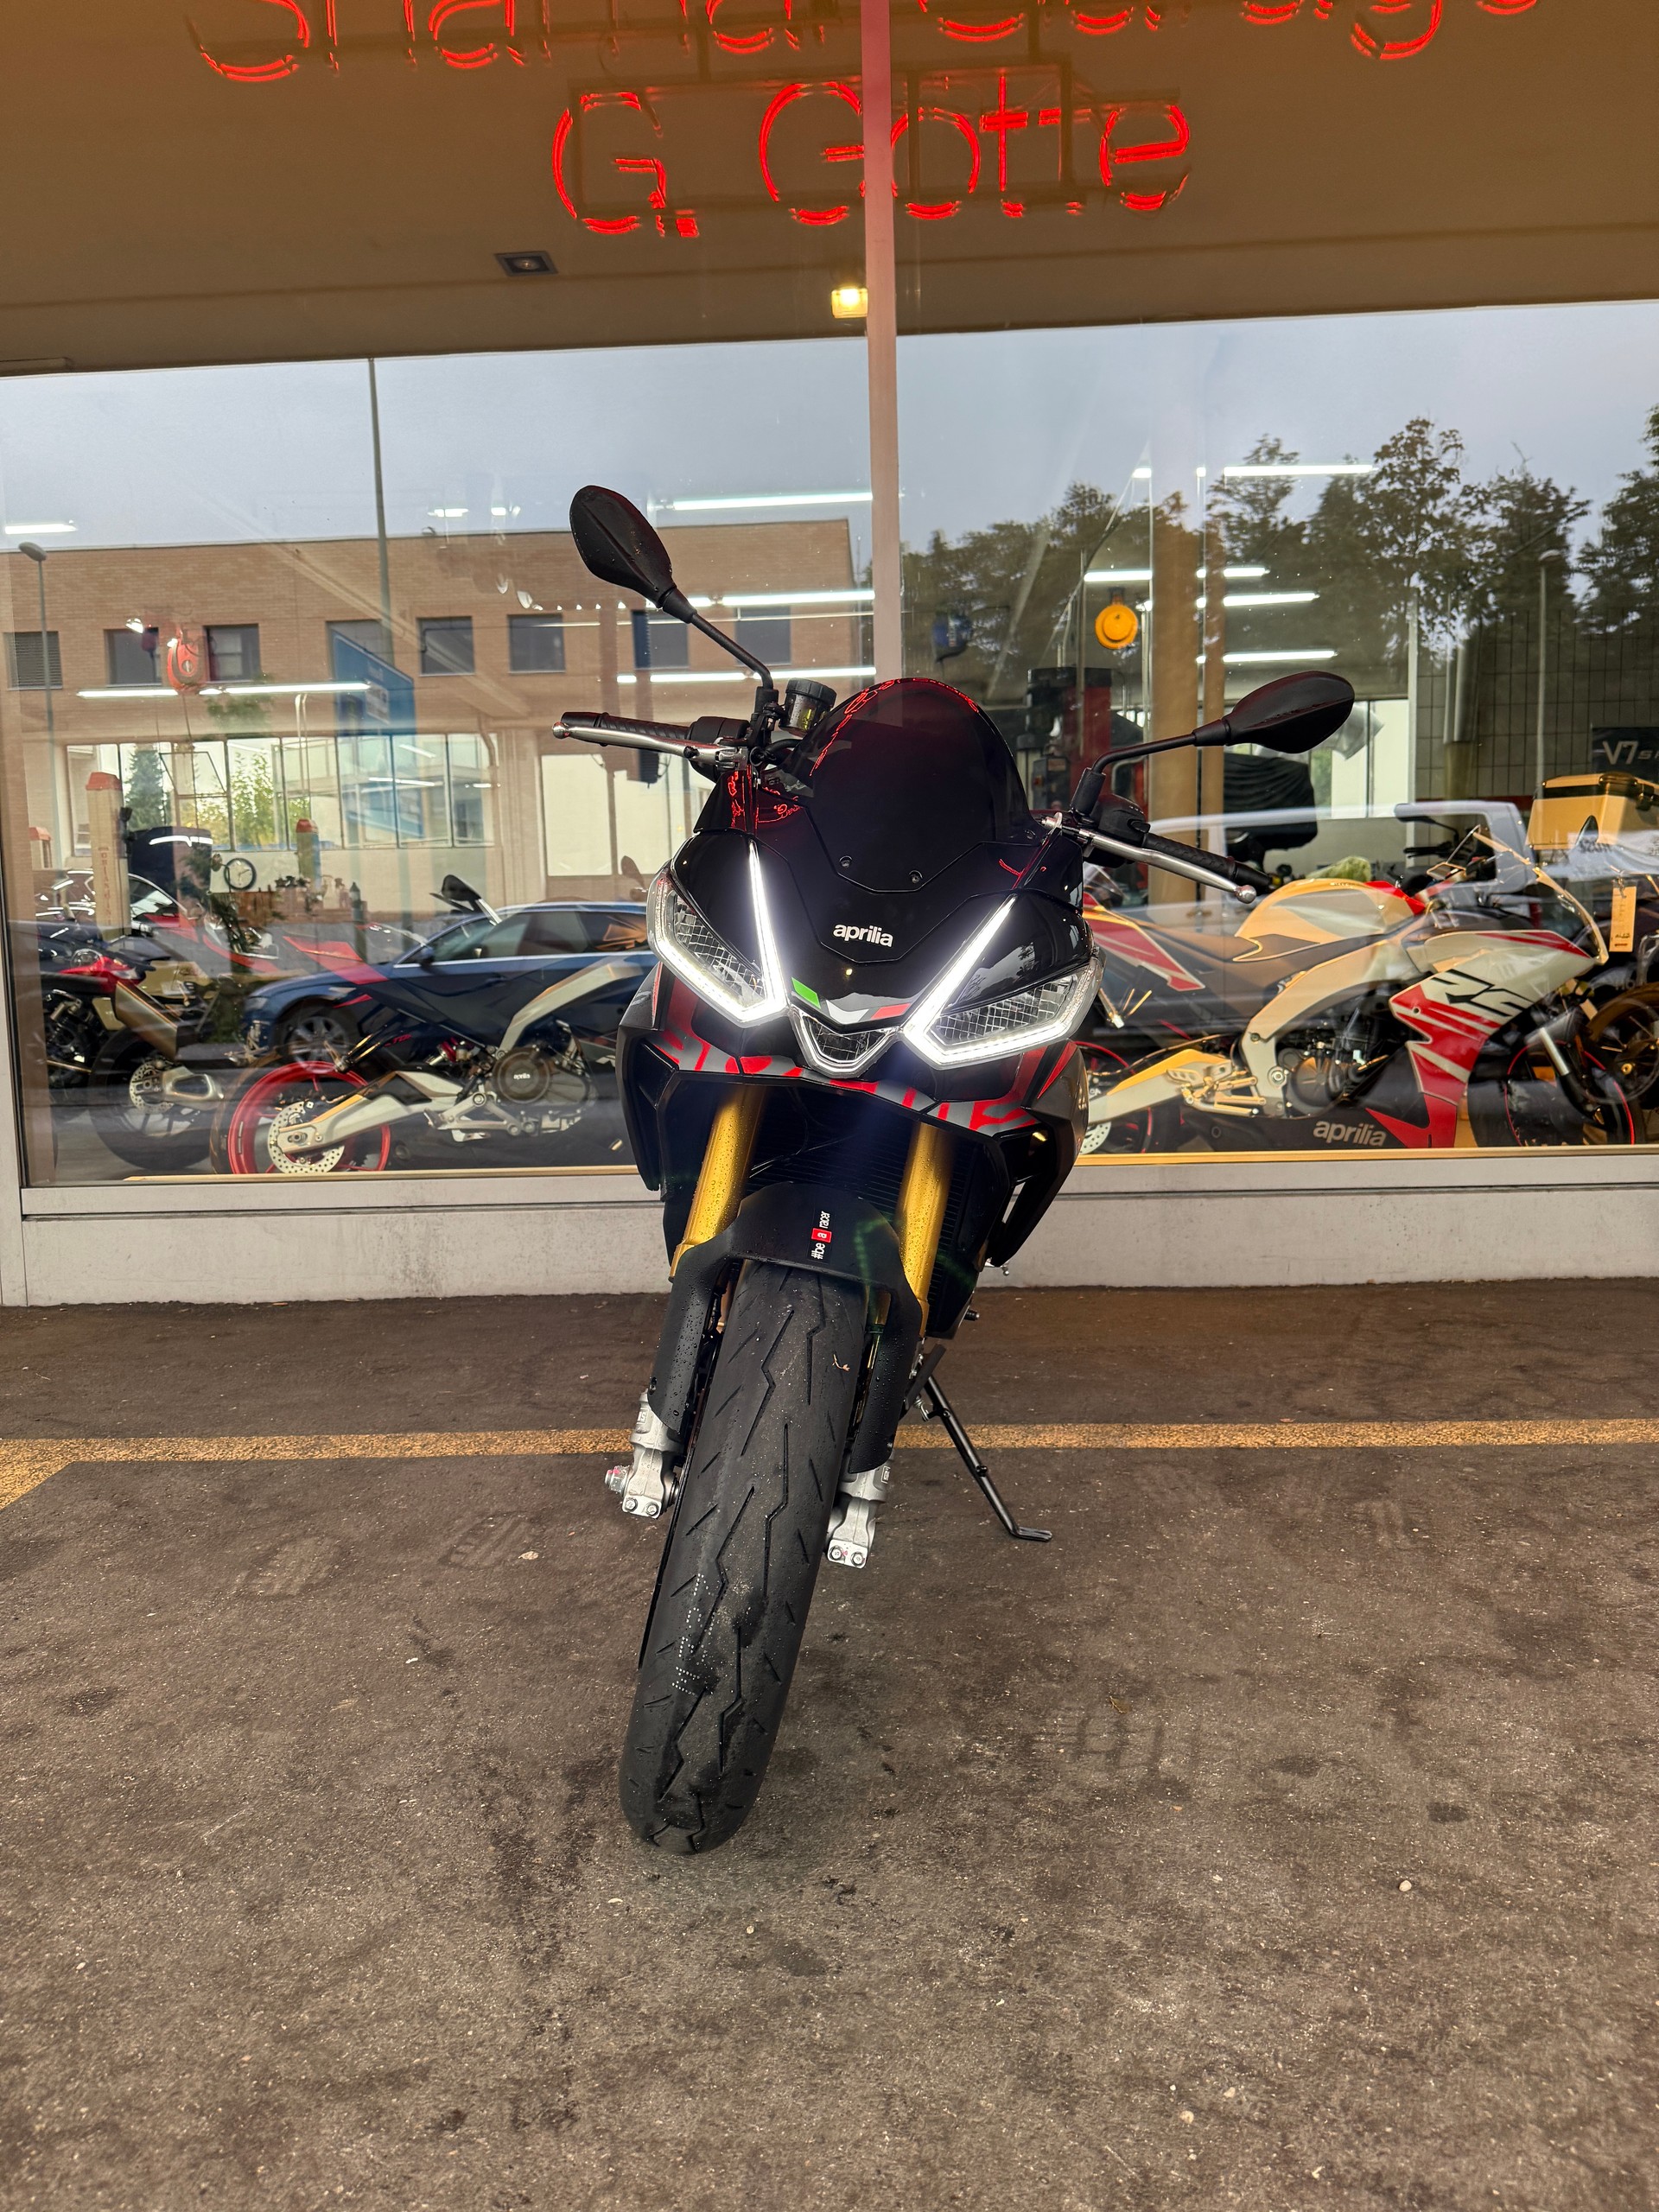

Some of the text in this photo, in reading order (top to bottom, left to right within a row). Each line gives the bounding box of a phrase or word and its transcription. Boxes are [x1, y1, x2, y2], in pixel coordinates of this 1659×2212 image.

[1602, 741, 1638, 766] V7
[833, 924, 893, 948] aprilia
[1313, 1121, 1387, 1147] aprilia
[811, 1243, 825, 1260] #be
[819, 1211, 830, 1229] racer
